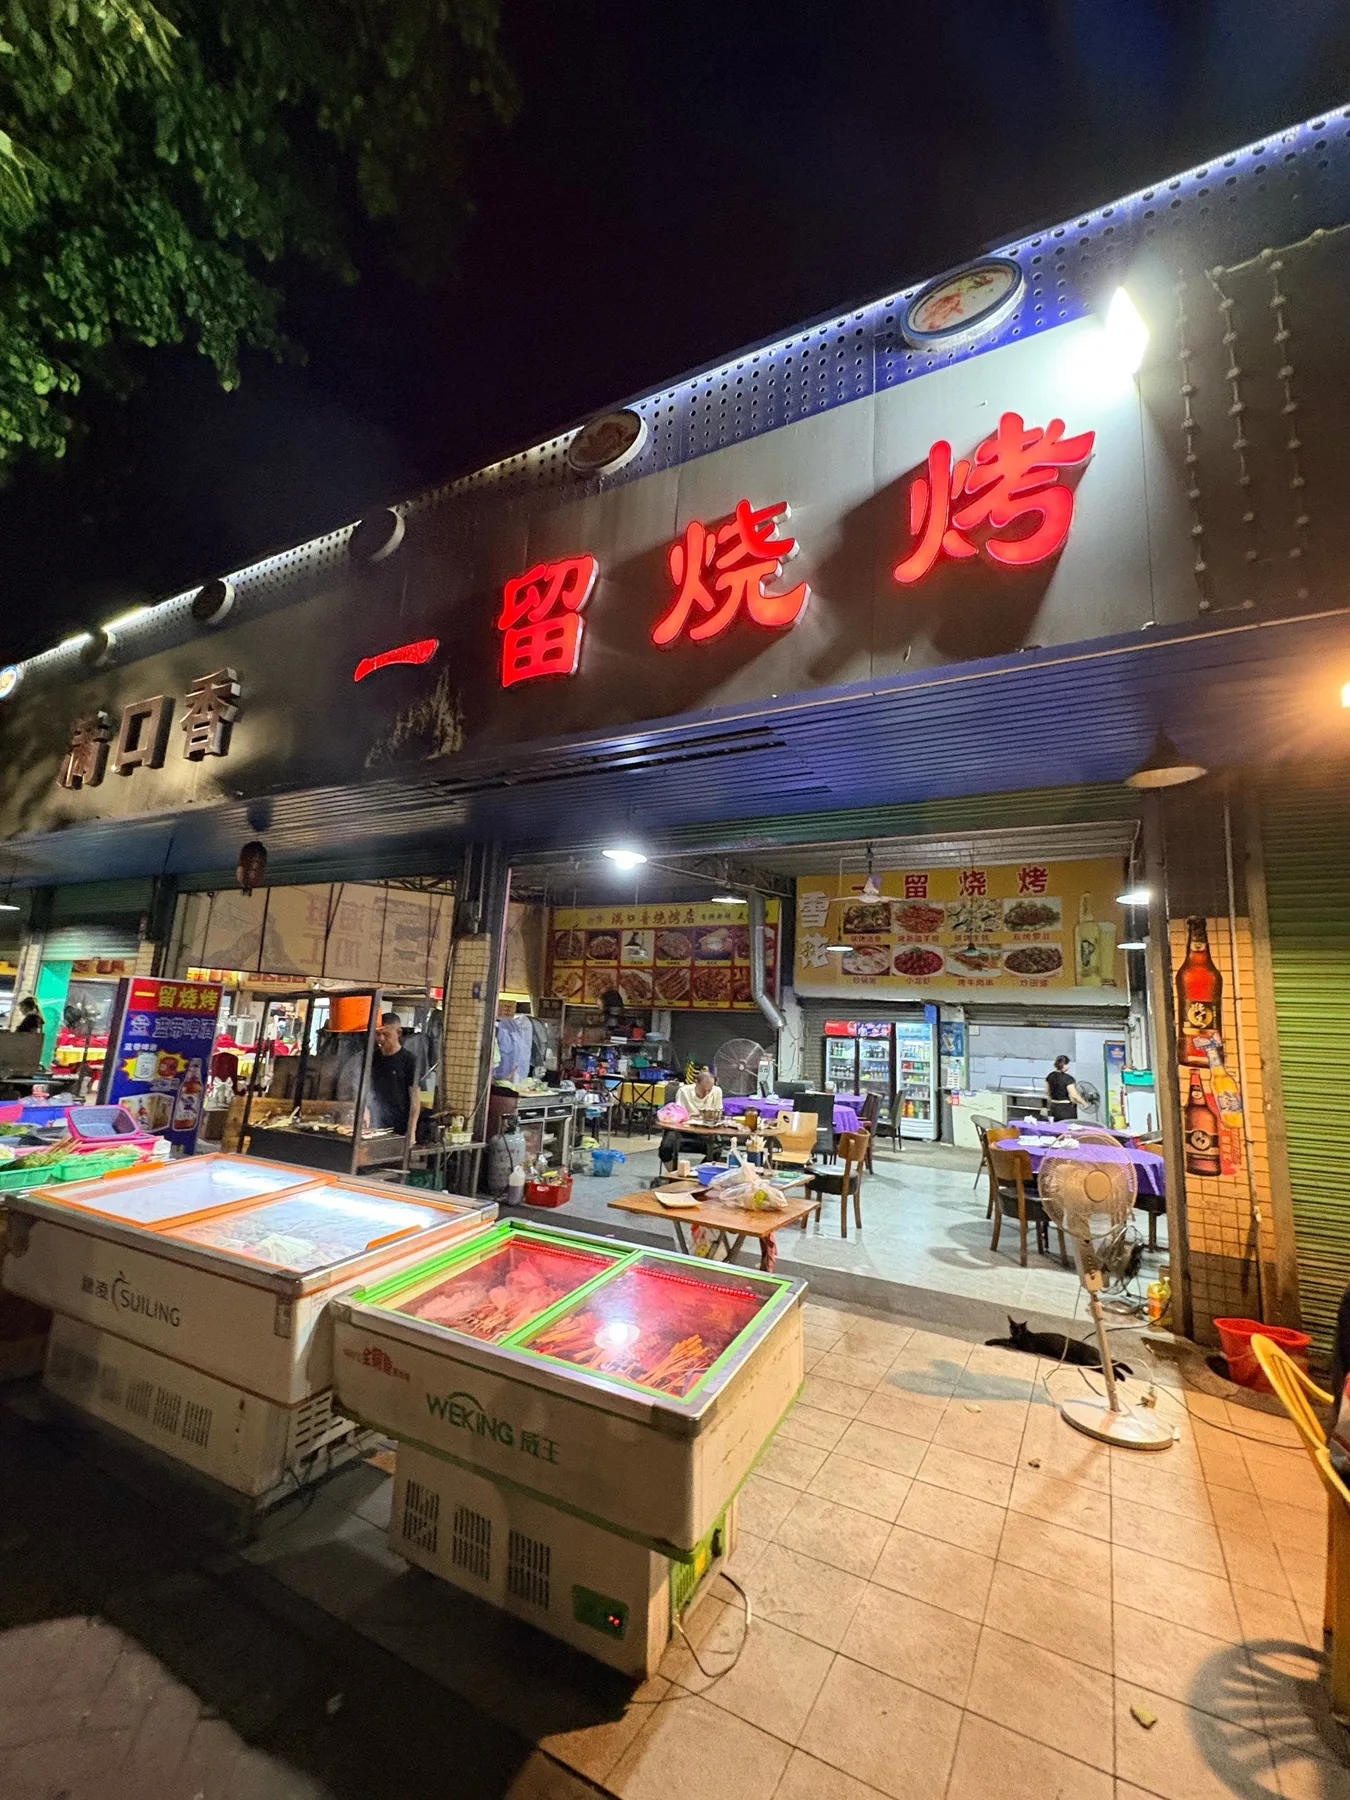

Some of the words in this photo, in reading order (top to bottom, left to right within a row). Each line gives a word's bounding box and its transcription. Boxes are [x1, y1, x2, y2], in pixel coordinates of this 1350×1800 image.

[352, 411, 1096, 690] 一留烧烤
[134, 985, 219, 1009] 一留烧烤
[120, 1288, 181, 1328] SUILING
[426, 1392, 515, 1447] WEKING
